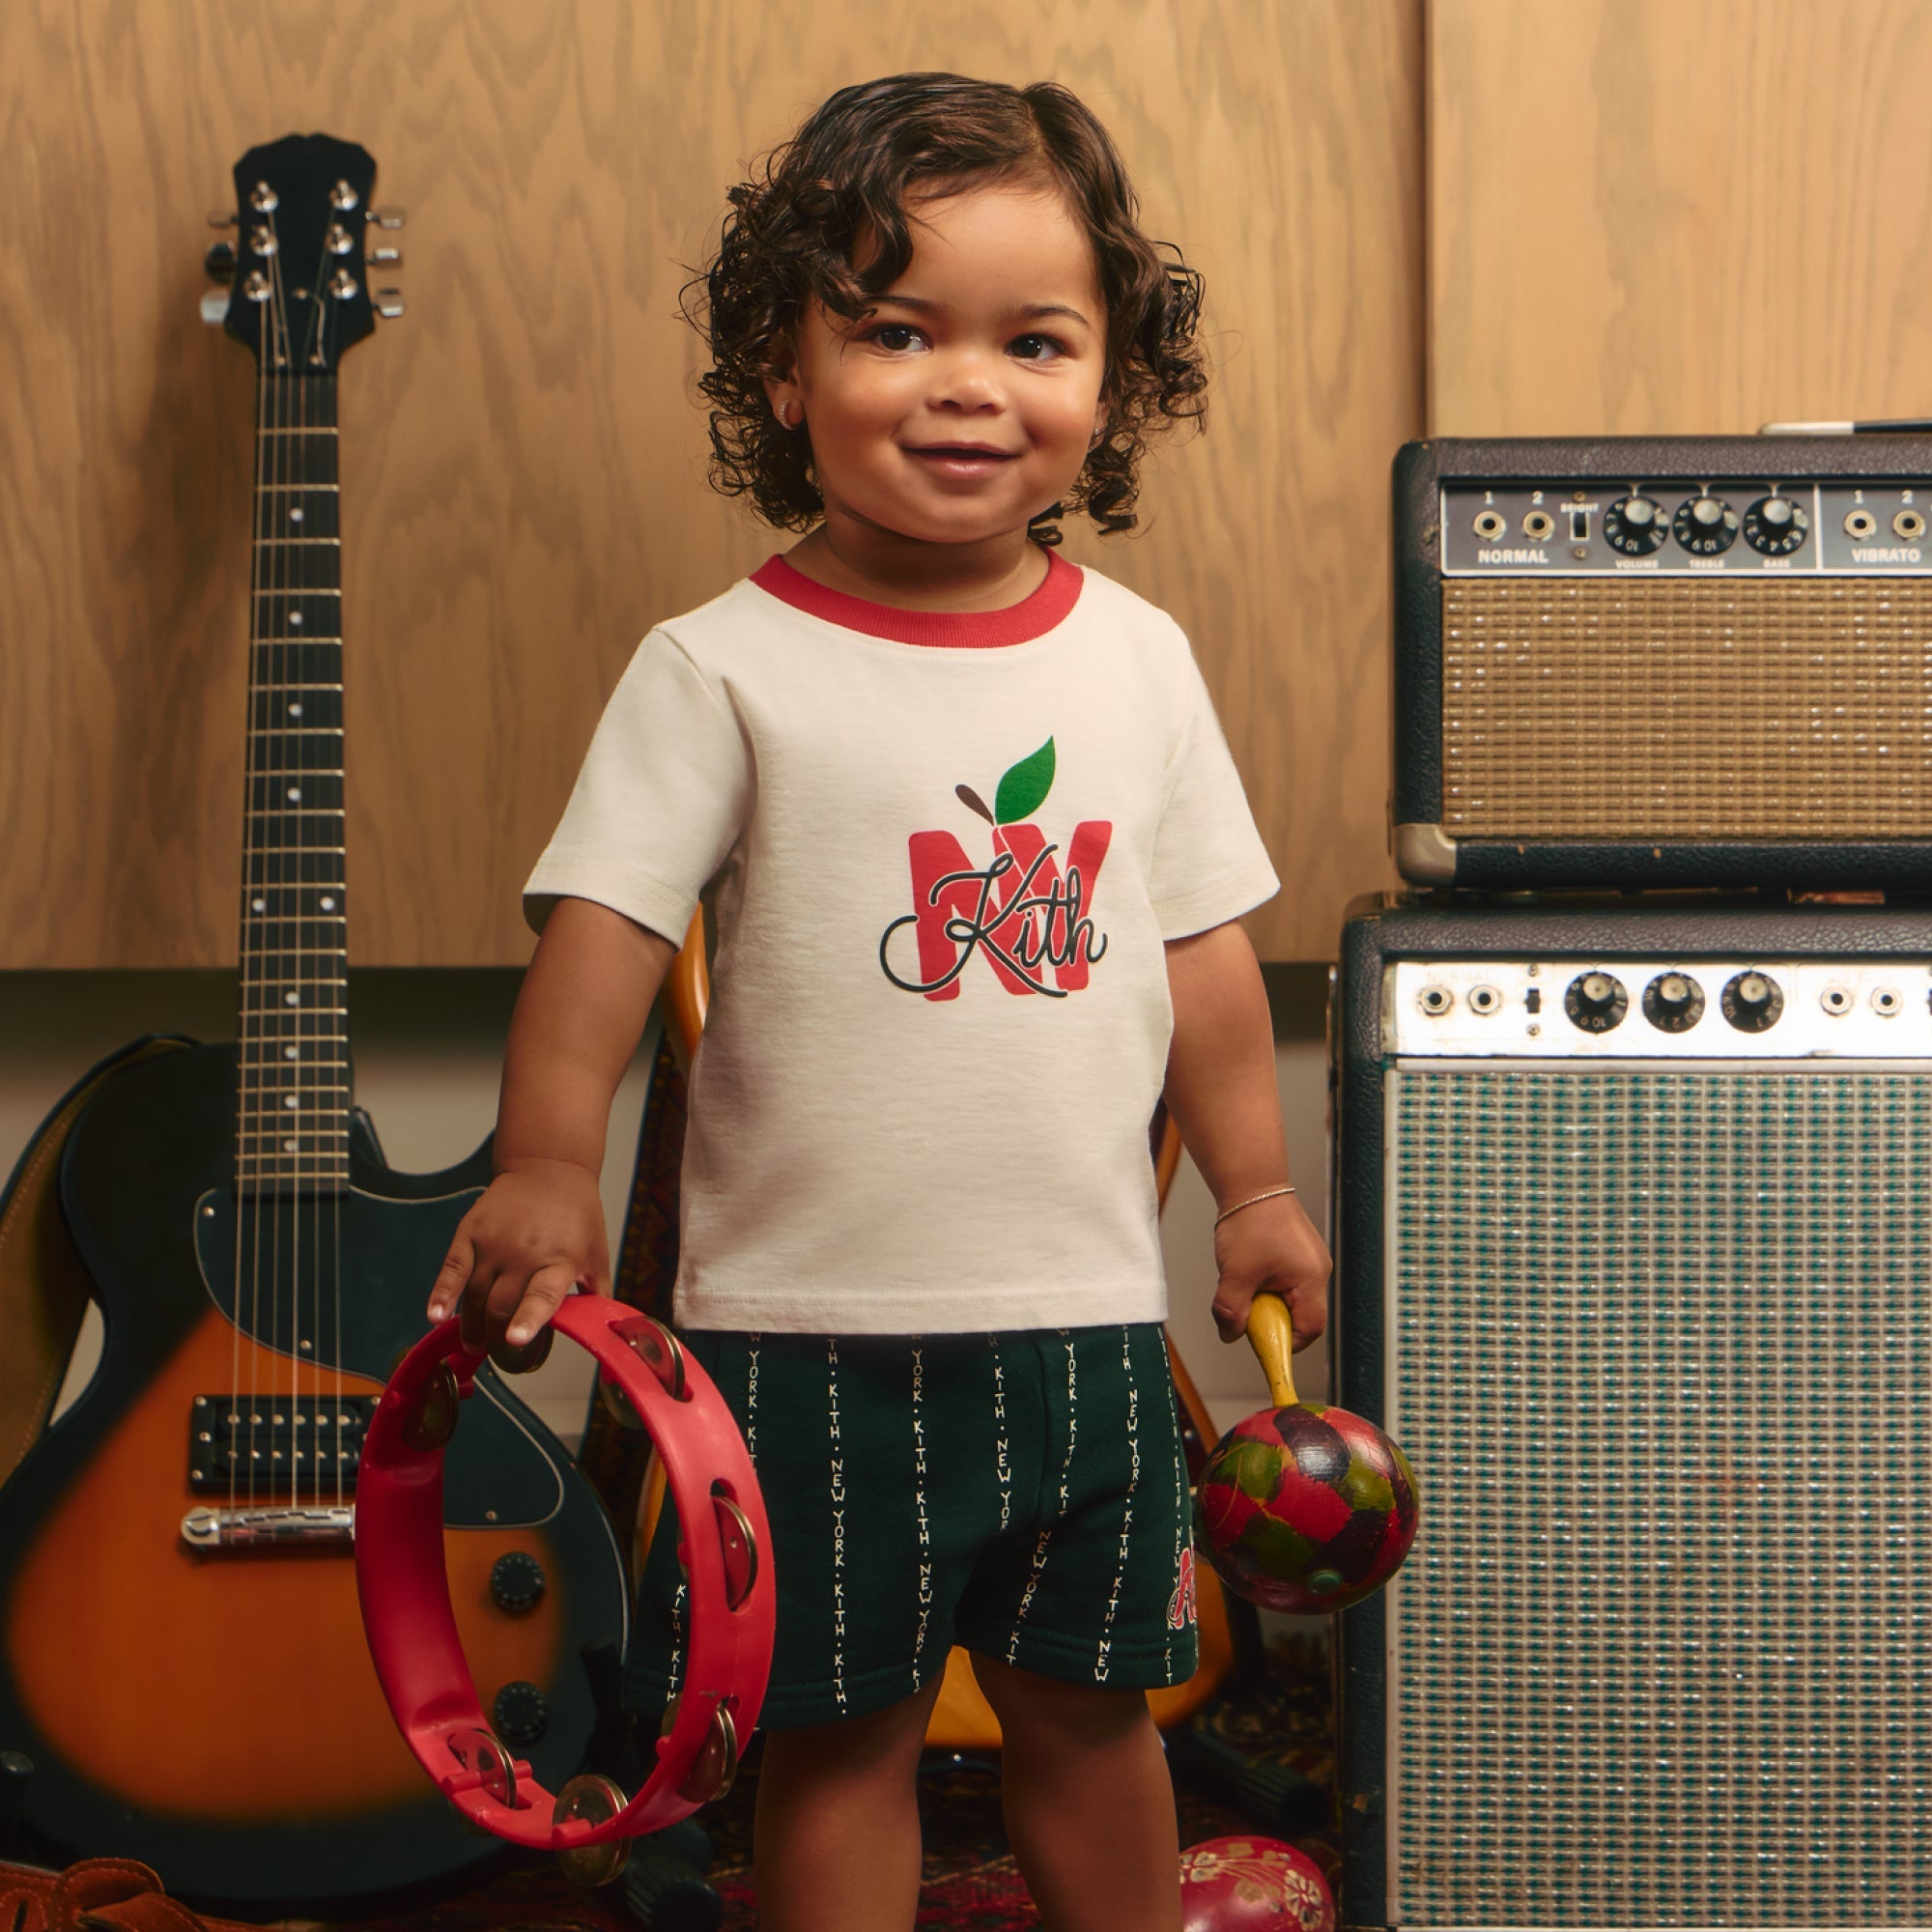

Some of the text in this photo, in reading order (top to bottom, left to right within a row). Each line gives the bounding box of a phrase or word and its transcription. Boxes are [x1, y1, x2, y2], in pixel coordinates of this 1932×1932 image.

[1485, 490, 1543, 504] 1 2
[1855, 490, 1913, 503] 1 2
[1478, 549, 1548, 563] NORMAL
[1615, 559, 1659, 569] VOLUME
[1690, 558, 1724, 569] TREBLE
[1763, 558, 1790, 569] BASS
[1851, 548, 1920, 562] VIBRATO
[879, 843, 1108, 998] Kith
[748, 1350, 760, 1408] YORK
[911, 1349, 923, 1404] YORK
[828, 1382, 840, 1439] KITH
[1058, 1343, 1077, 1518] YORK KITH KIT
[1126, 1388, 1138, 1433] NEW
[748, 1426, 758, 1474] KIT
[912, 1419, 926, 1474] KITH
[994, 1365, 1011, 1532] KITH NEW YOR
[1127, 1437, 1141, 1493] YORK
[830, 1458, 845, 1502] NEW
[832, 1509, 845, 1567] YORK
[916, 1491, 930, 1546] KITH
[1119, 1509, 1132, 1560] KITH
[918, 1562, 933, 1604] NEW
[1006, 1529, 1052, 1665] NEW YORK KIT
[1104, 1576, 1122, 1623] KITH
[833, 1582, 845, 1637] KITH
[666, 1649, 681, 1702] KITH
[833, 1653, 846, 1703] KITH
[1094, 1639, 1111, 1683] NEW
